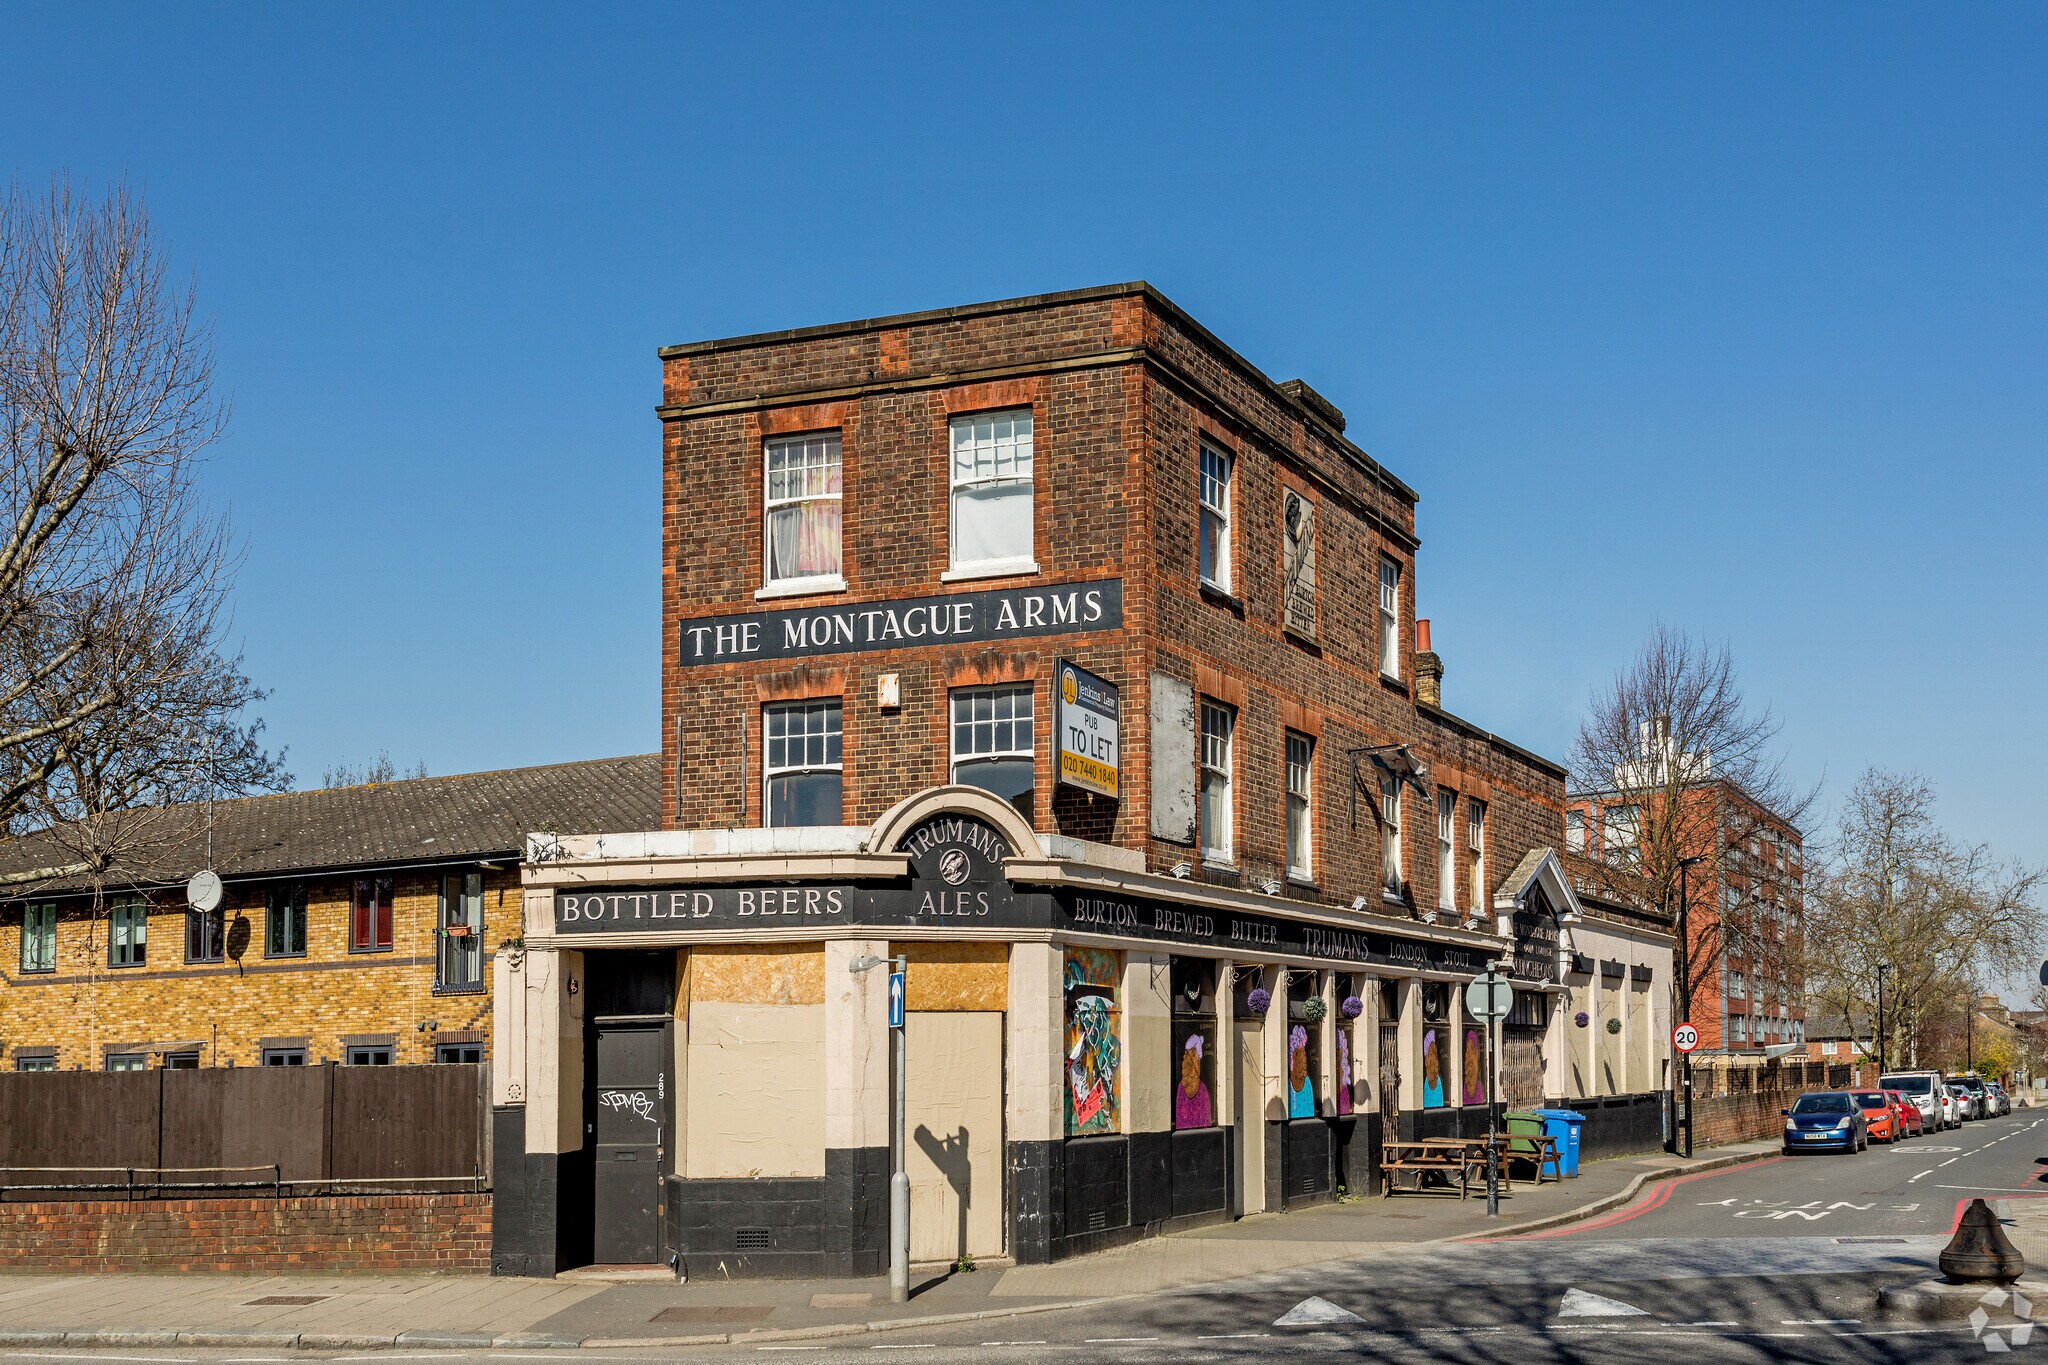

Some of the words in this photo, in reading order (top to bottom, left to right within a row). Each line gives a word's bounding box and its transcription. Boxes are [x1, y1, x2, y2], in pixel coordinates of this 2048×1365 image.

[688, 622, 762, 657] THE
[783, 602, 975, 649] MONTAGUE
[994, 590, 1103, 631] ARMS
[1103, 692, 1116, 709] Law
[1084, 713, 1098, 730] PUB
[1069, 726, 1087, 754] TO
[1090, 733, 1113, 763] LET
[1063, 756, 1078, 773] 020
[1079, 761, 1097, 779] 7440
[1099, 768, 1116, 785] 1840
[902, 818, 1005, 864] TRUMANS
[562, 892, 715, 922] BOTTLED
[738, 889, 844, 917] BEERS
[917, 890, 990, 917] ALES
[1074, 897, 1138, 928] BURTON
[1154, 908, 1215, 938] BREWED
[1230, 919, 1278, 946] BITTER
[1302, 927, 1370, 961] TRUMANS
[1389, 942, 1429, 963] LONDON
[1443, 949, 1471, 968] STOUT
[1515, 958, 1554, 979] LUNCHEONS
[1676, 1031, 1697, 1044] 20
